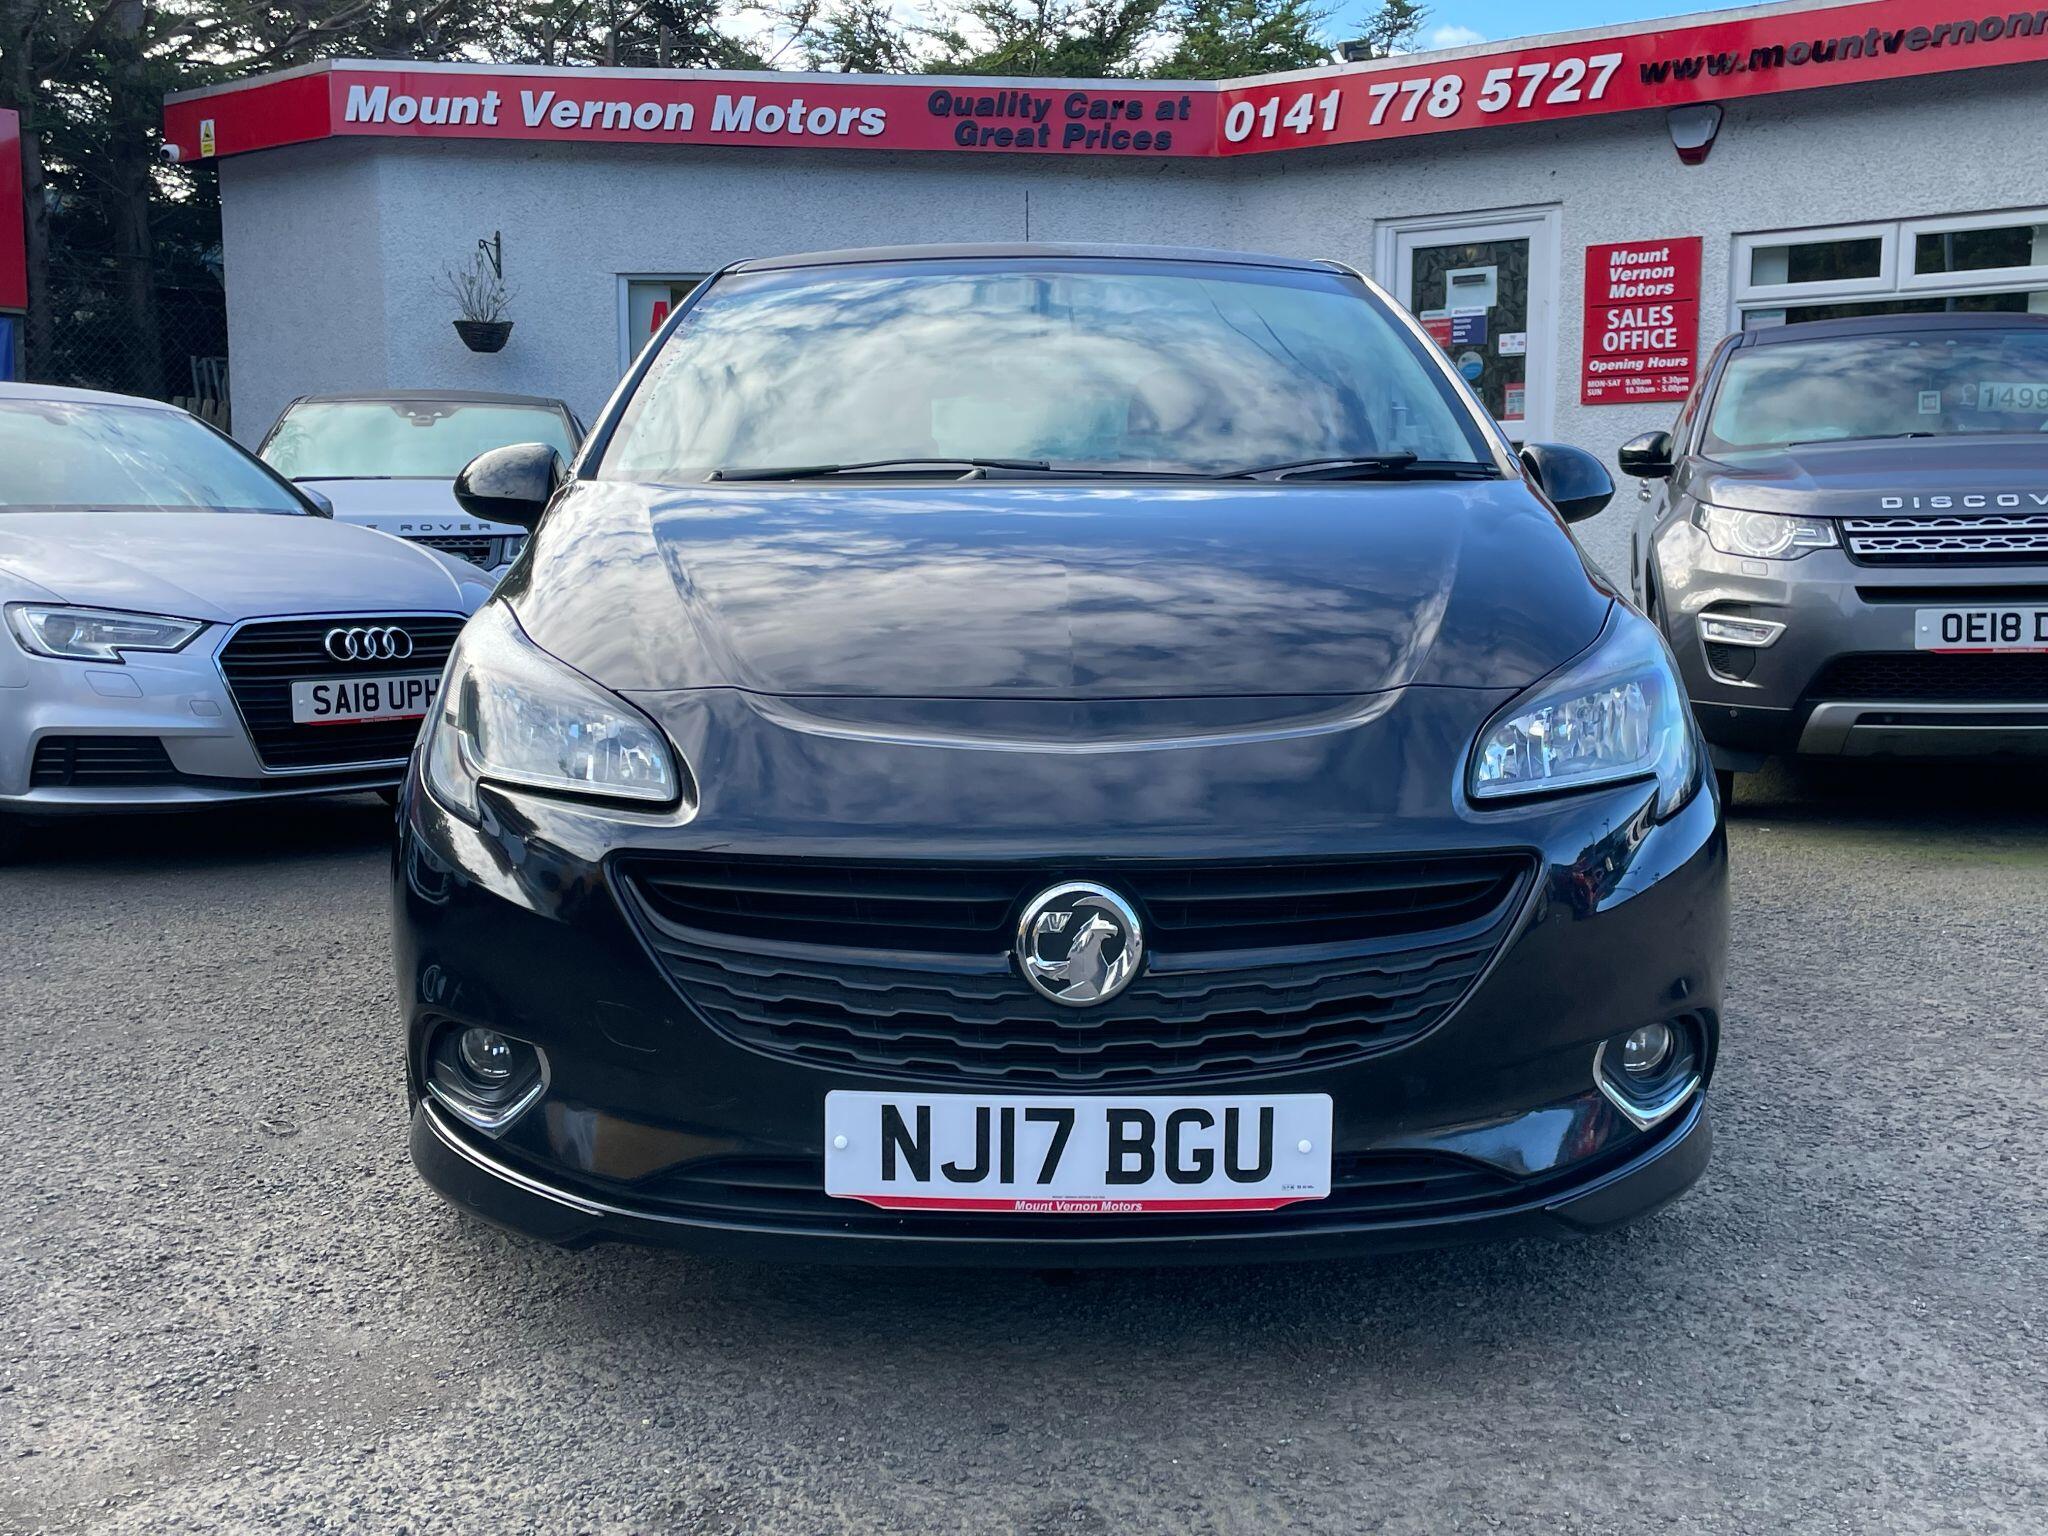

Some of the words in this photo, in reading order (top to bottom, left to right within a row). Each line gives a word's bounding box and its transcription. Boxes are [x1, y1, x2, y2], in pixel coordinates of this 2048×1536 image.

[345, 85, 501, 125] Mount
[520, 90, 695, 131] Vernon
[710, 94, 887, 136] Motors
[928, 90, 1052, 123] Quality
[1064, 92, 1143, 121] Cars
[1155, 95, 1192, 121] at
[1224, 89, 1343, 143] 0141
[1368, 74, 1463, 125] 778
[1476, 53, 1623, 113] 5727
[954, 119, 1051, 148] Great
[1062, 122, 1172, 150] Prices
[1610, 247, 1669, 266] Mount
[1609, 265, 1675, 282] Vernon
[1609, 283, 1675, 299] Motors
[1607, 305, 1674, 330] SALES
[1602, 327, 1678, 352] OFFICE
[1589, 358, 1644, 373] Opening
[1647, 357, 1689, 368] Hours
[1587, 379, 1621, 388] MON-SAT
[1587, 388, 1602, 396] SUN
[1942, 612, 2022, 643] OE18
[312, 682, 380, 715] SA18
[388, 678, 440, 710] UPH
[881, 1104, 1075, 1184] NJ17
[1105, 1107, 1275, 1184] BGU
[1014, 1200, 1053, 1211] Mount
[1055, 1201, 1098, 1211] Vernon
[1100, 1201, 1143, 1211] Motors
